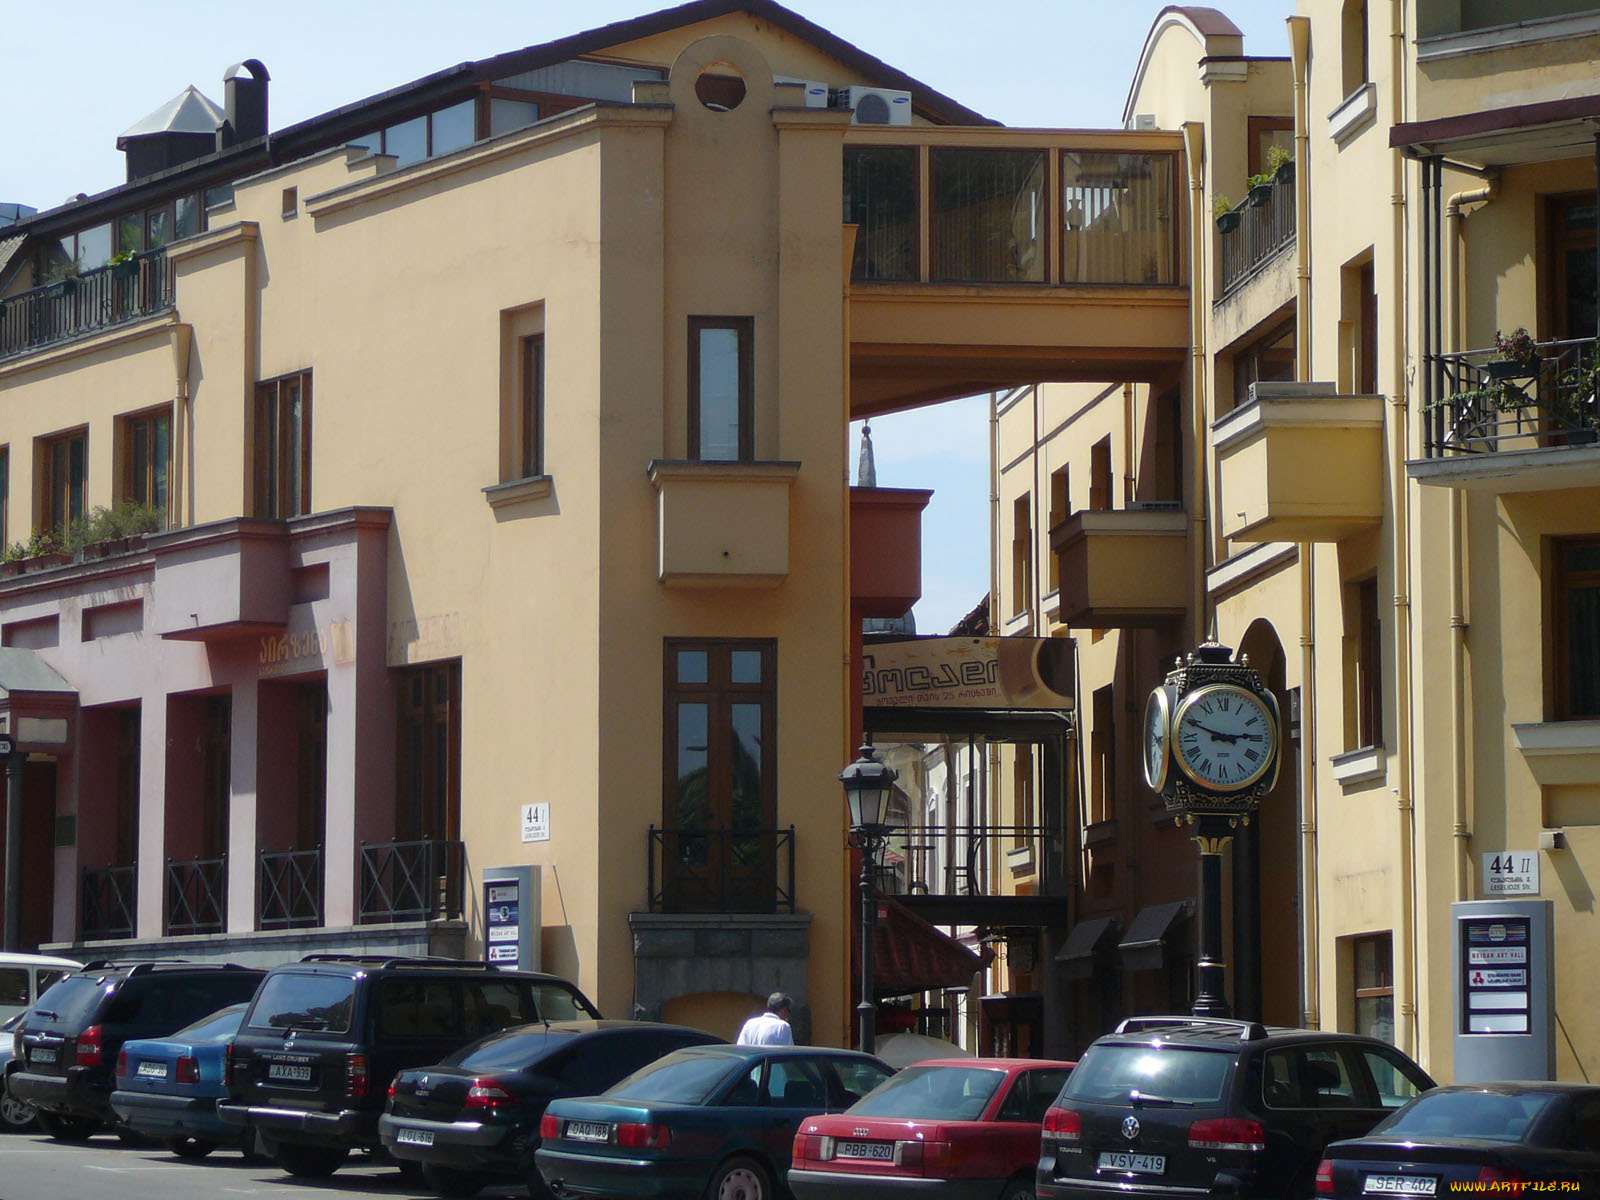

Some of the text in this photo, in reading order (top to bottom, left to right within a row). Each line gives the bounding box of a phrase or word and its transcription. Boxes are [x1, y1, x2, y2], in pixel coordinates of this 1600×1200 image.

[1200, 701, 1214, 715] XI
[1217, 698, 1229, 712] XII
[526, 806, 539, 823] 44
[1490, 855, 1531, 874] 44 II
[1109, 1154, 1163, 1170] VSV-419
[1376, 1176, 1434, 1192] SER-402
